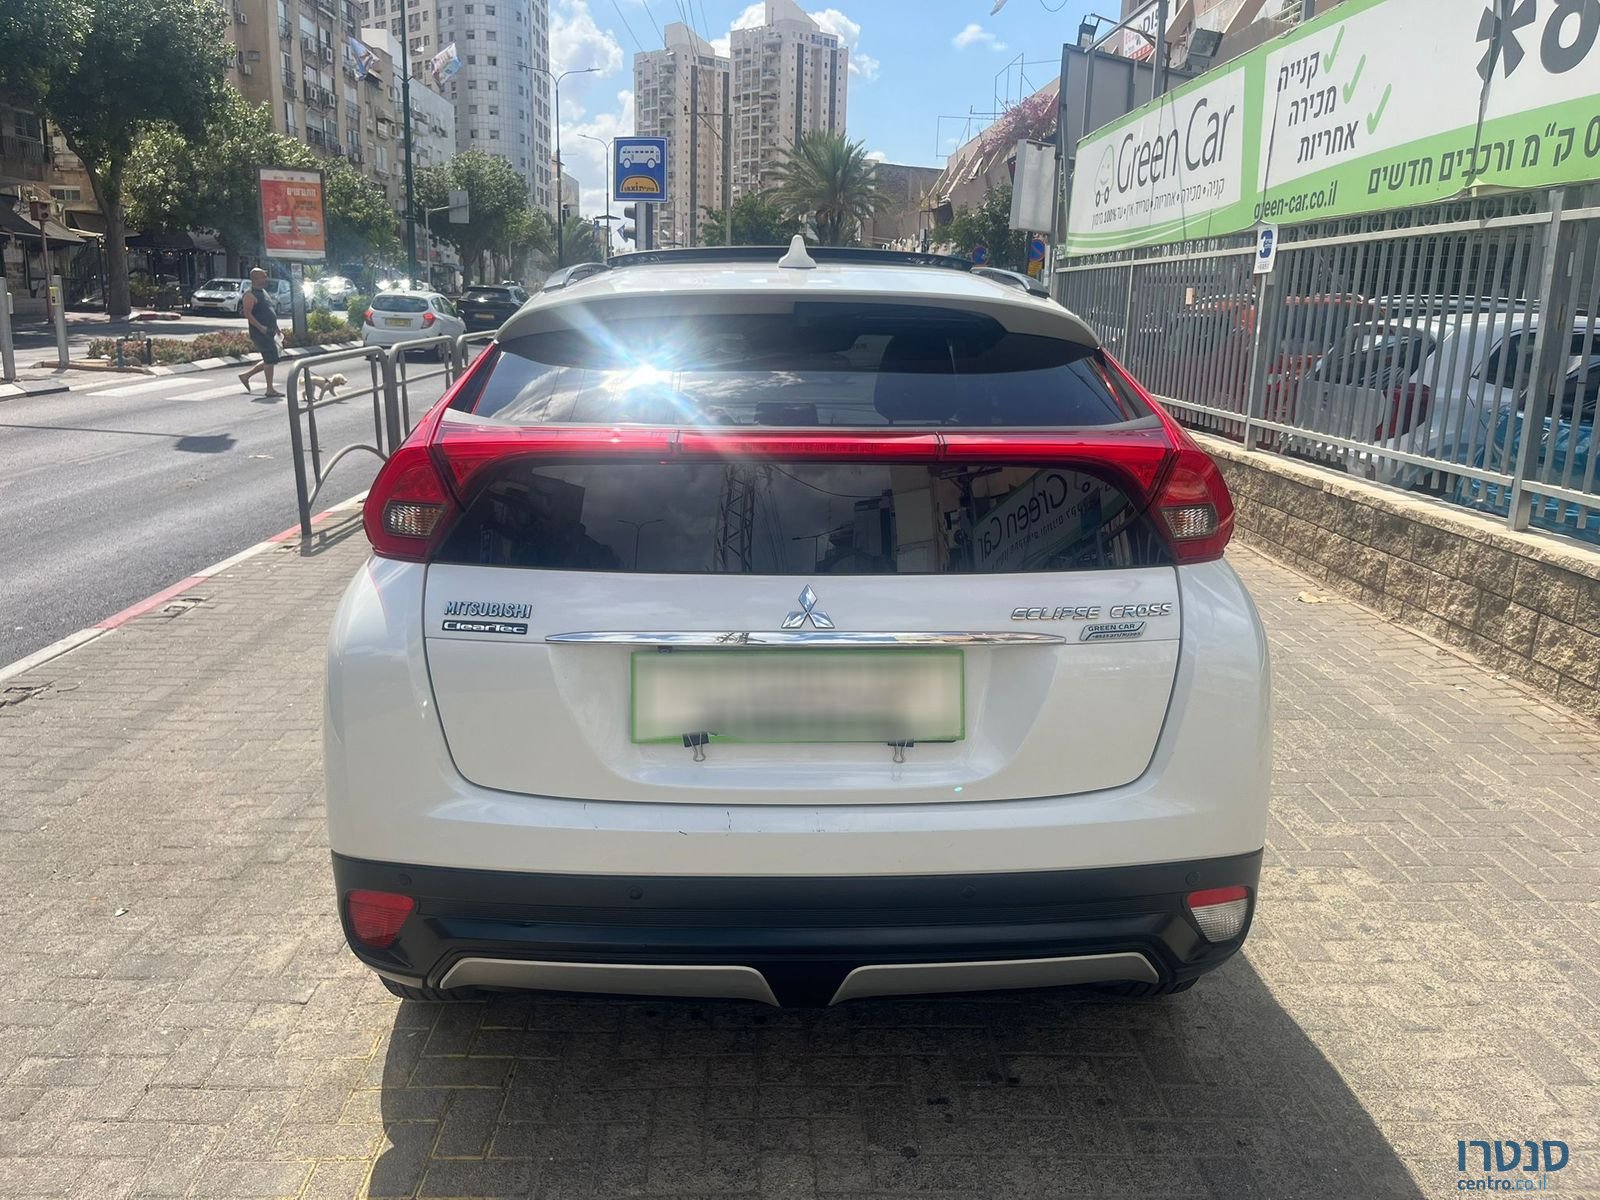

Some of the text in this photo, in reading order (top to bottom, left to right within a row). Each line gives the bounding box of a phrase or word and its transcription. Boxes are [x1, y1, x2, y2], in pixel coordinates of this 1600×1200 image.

[1277, 51, 1320, 92] קנייה
[1288, 85, 1337, 127] מכירה
[1117, 97, 1235, 194] Green Car
[1297, 120, 1359, 164] אחריות
[1367, 157, 1433, 194] חדשים
[443, 621, 525, 633] ClearTec
[444, 601, 532, 619] MITSUBISHI
[1011, 602, 1172, 621] ECLIPSE CROSS
[1088, 624, 1117, 632] GREEN
